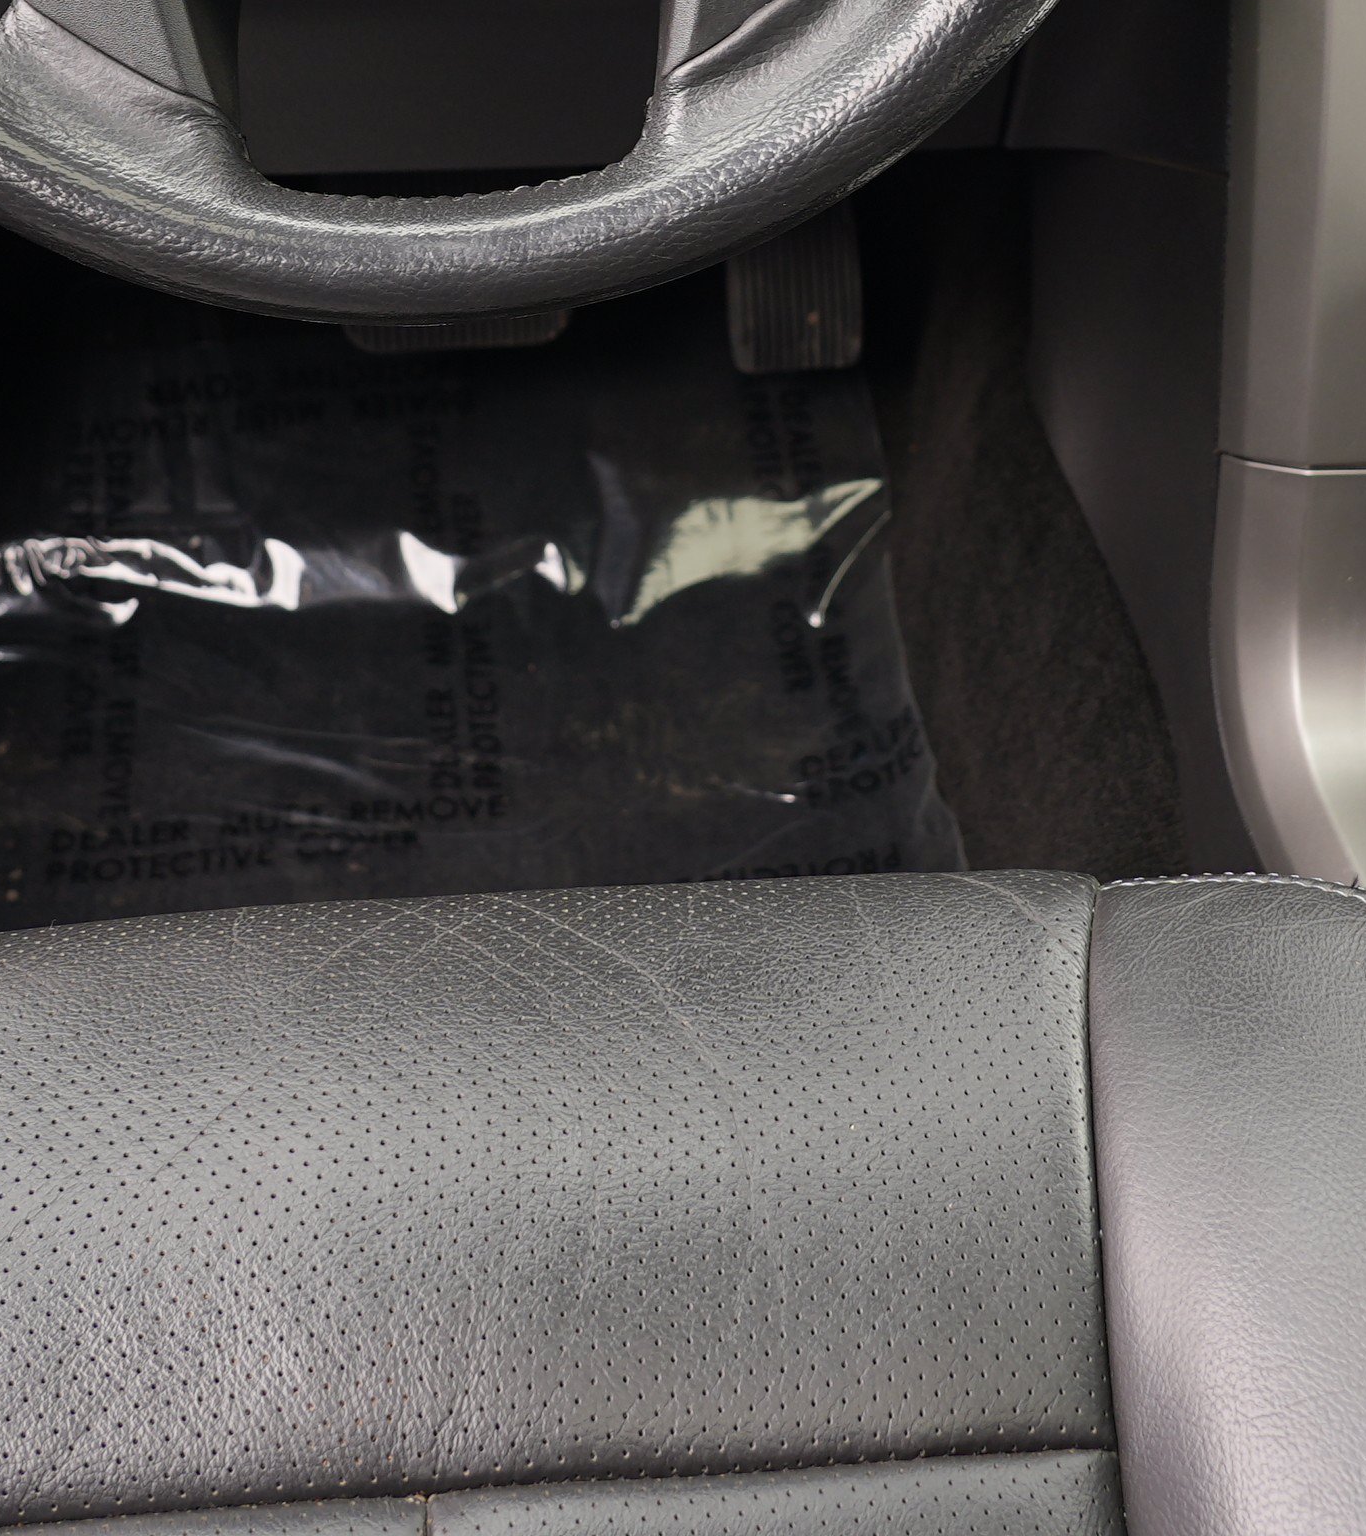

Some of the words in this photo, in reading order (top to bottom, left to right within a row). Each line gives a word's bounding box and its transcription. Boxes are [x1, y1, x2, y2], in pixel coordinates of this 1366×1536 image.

[50, 819, 191, 854] DEALER
[349, 792, 508, 821] REMOVE
[45, 844, 274, 884] PROTECTIVE
